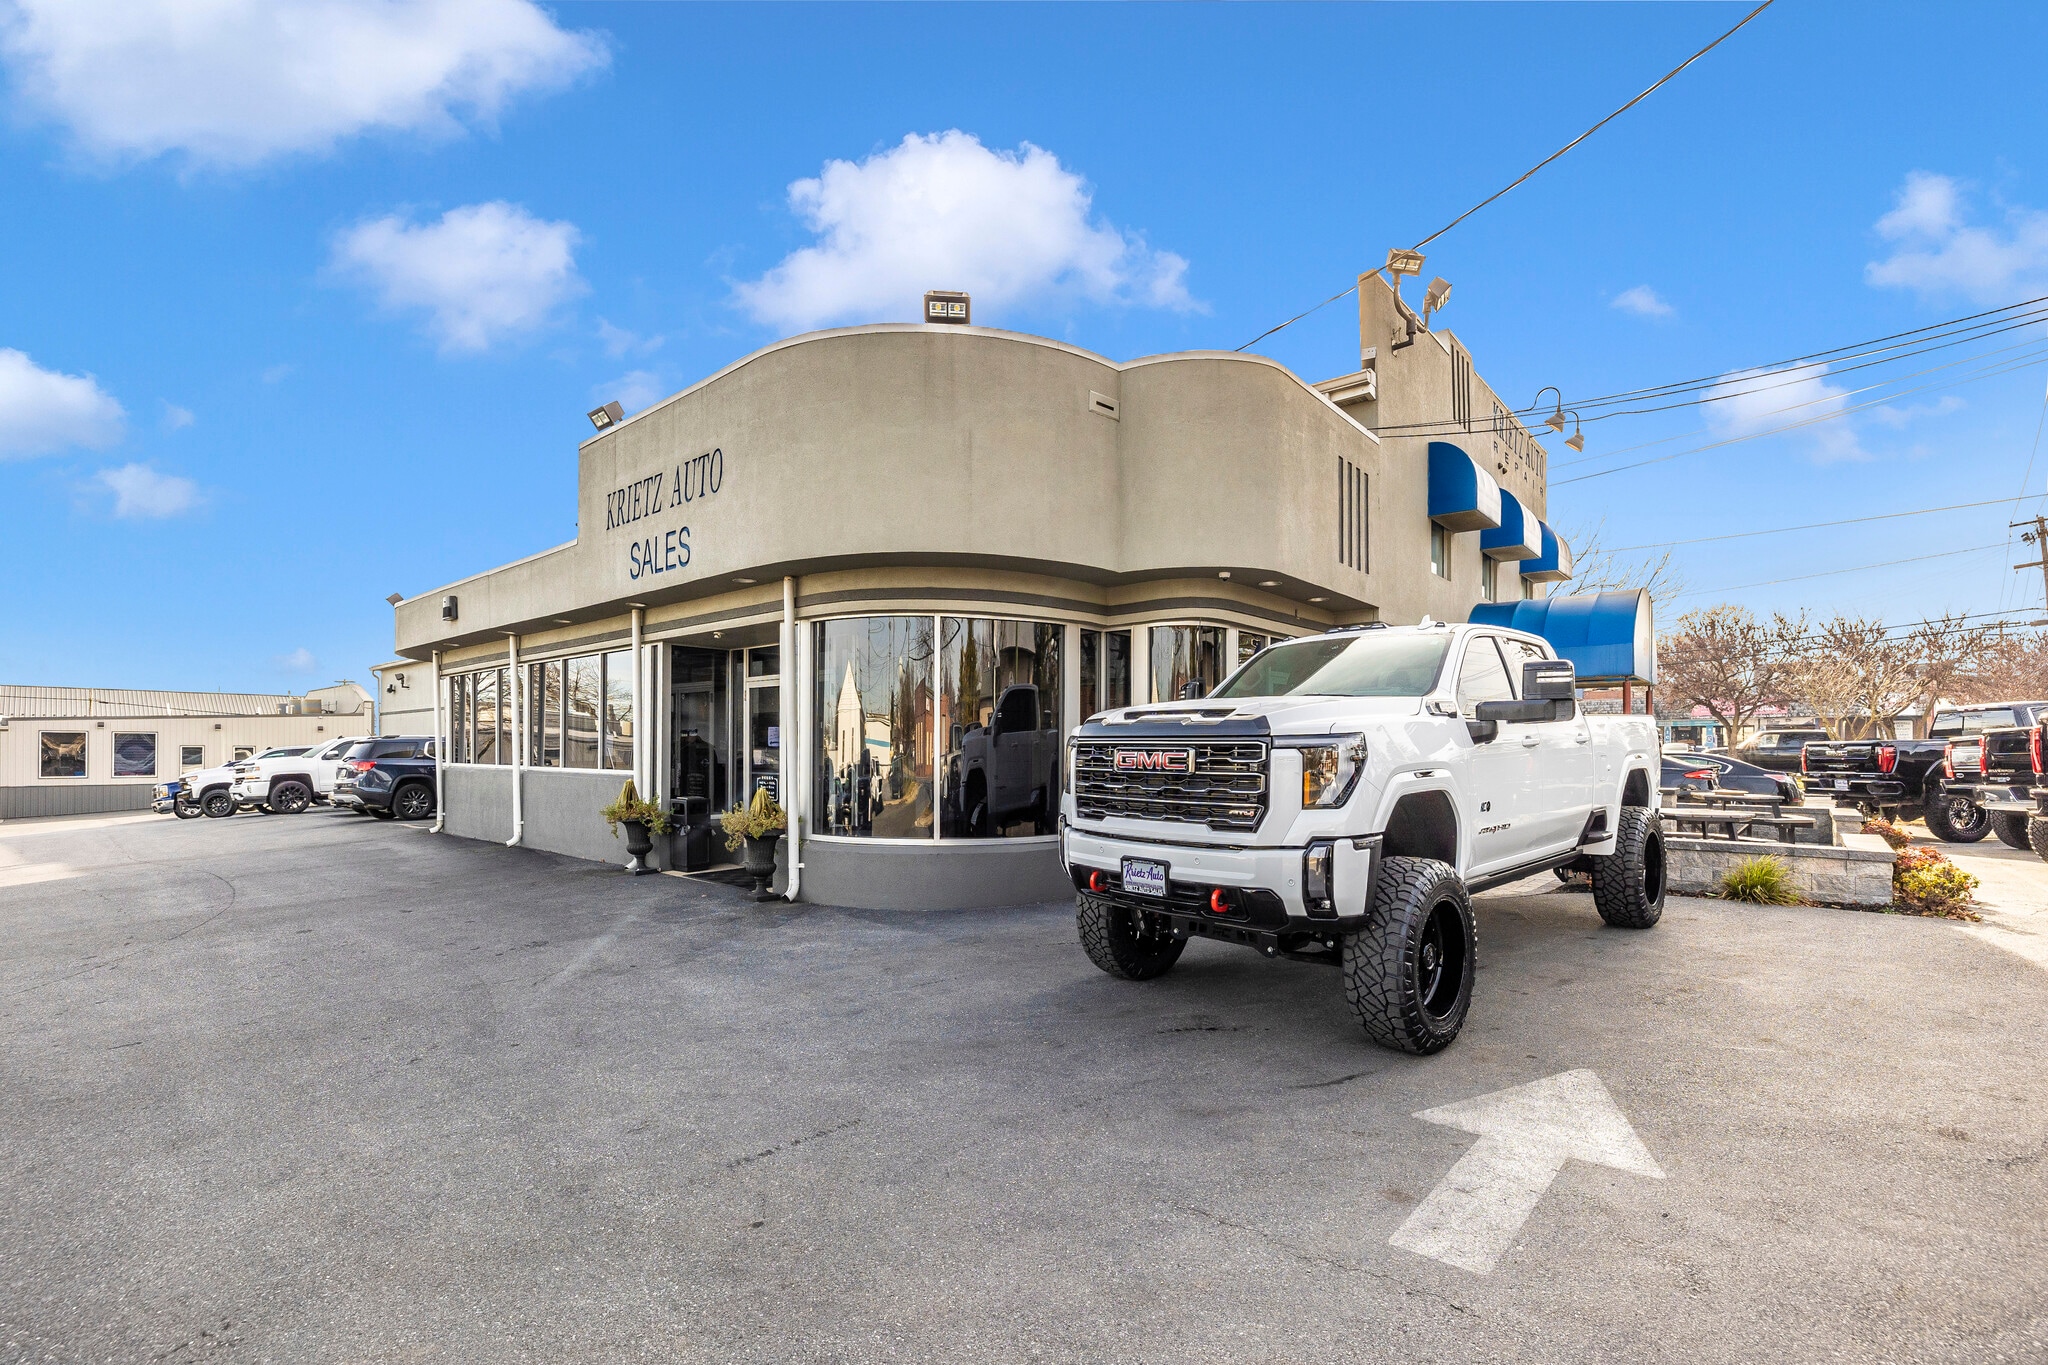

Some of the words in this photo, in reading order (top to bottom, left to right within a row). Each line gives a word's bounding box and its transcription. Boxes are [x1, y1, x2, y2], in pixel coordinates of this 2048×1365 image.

[1493, 401, 1523, 460] KRIETZ
[1525, 440, 1544, 480] AUTO
[606, 472, 663, 531] KRIETZ
[670, 448, 723, 508] AUTO
[1493, 441, 1544, 498] REPAIR
[629, 526, 691, 580] SALES
[1116, 752, 1188, 770] GMC
[1124, 863, 1145, 881] Krietz
[1146, 866, 1164, 881] Auto
